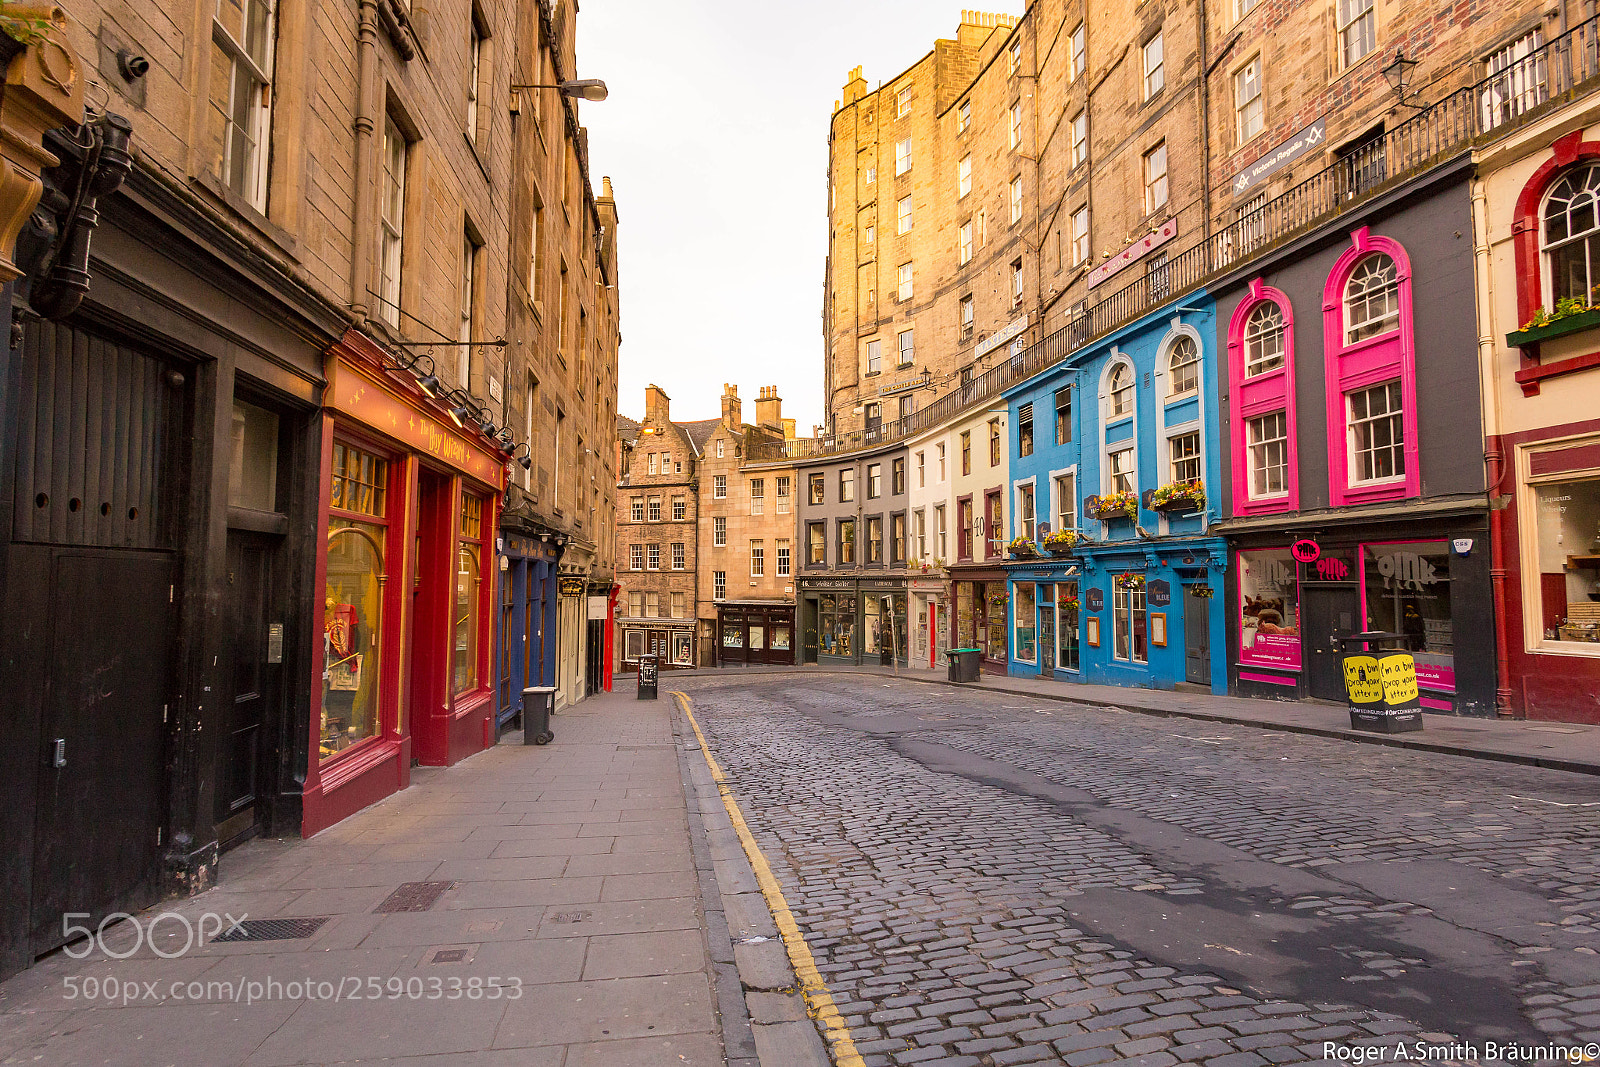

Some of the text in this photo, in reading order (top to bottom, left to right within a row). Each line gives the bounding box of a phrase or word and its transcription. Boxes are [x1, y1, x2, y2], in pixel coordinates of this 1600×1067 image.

[1252, 141, 1302, 176] Victoria Regalia
[420, 418, 465, 464] The Boy Wizard
[1540, 495, 1571, 503] Liqueurs
[973, 516, 985, 537] 40
[1366, 662, 1379, 673] bin
[1394, 664, 1401, 672] a
[1402, 661, 1414, 671] bin
[1348, 678, 1380, 687] Drop your
[1383, 676, 1416, 688] Drop your
